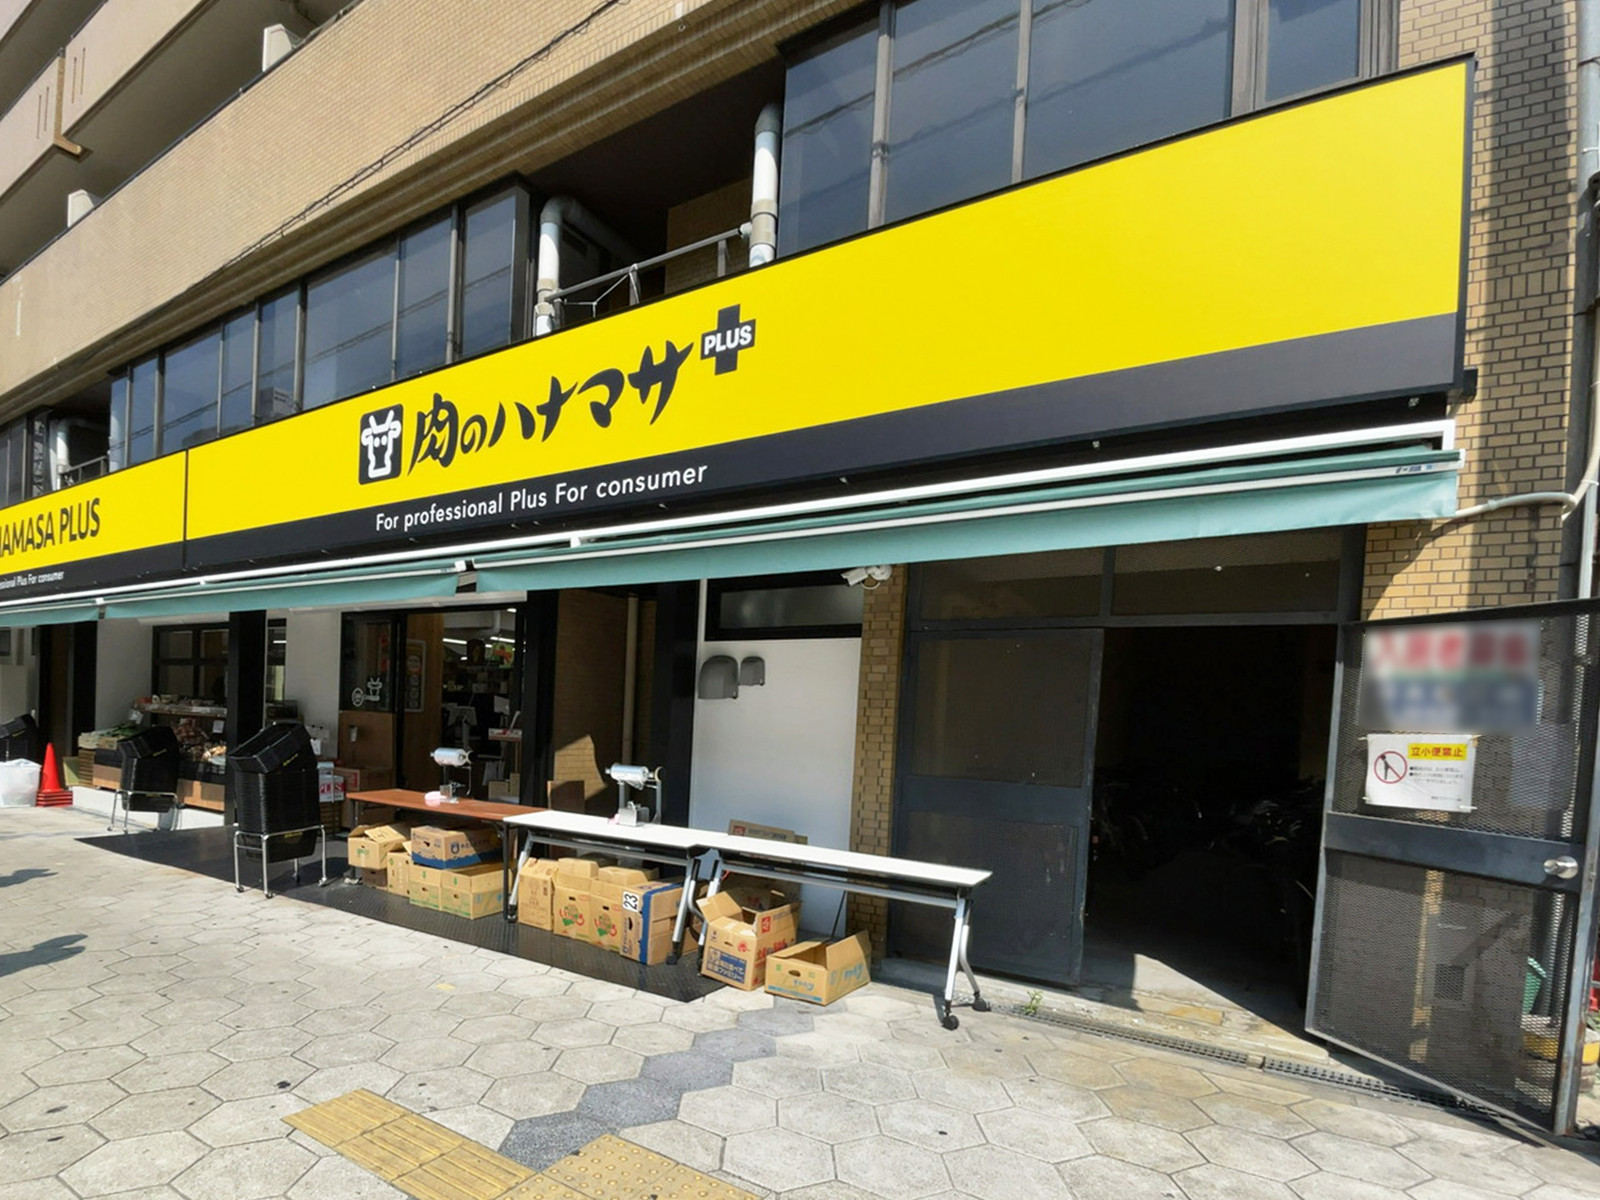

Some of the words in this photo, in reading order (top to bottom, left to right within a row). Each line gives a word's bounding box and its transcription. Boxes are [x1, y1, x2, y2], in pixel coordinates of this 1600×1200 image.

[704, 325, 753, 355] PLUS
[406, 340, 694, 476] 肉のハナマサ
[376, 512, 400, 531] For
[404, 492, 503, 532] professional
[511, 489, 548, 512] Plus
[556, 482, 588, 505] For
[597, 465, 708, 498] consumer
[0, 511, 56, 557] AMASA
[60, 497, 100, 544] PLUS
[1410, 746, 1464, 758] 立小便禁止
[623, 893, 638, 910] 23
